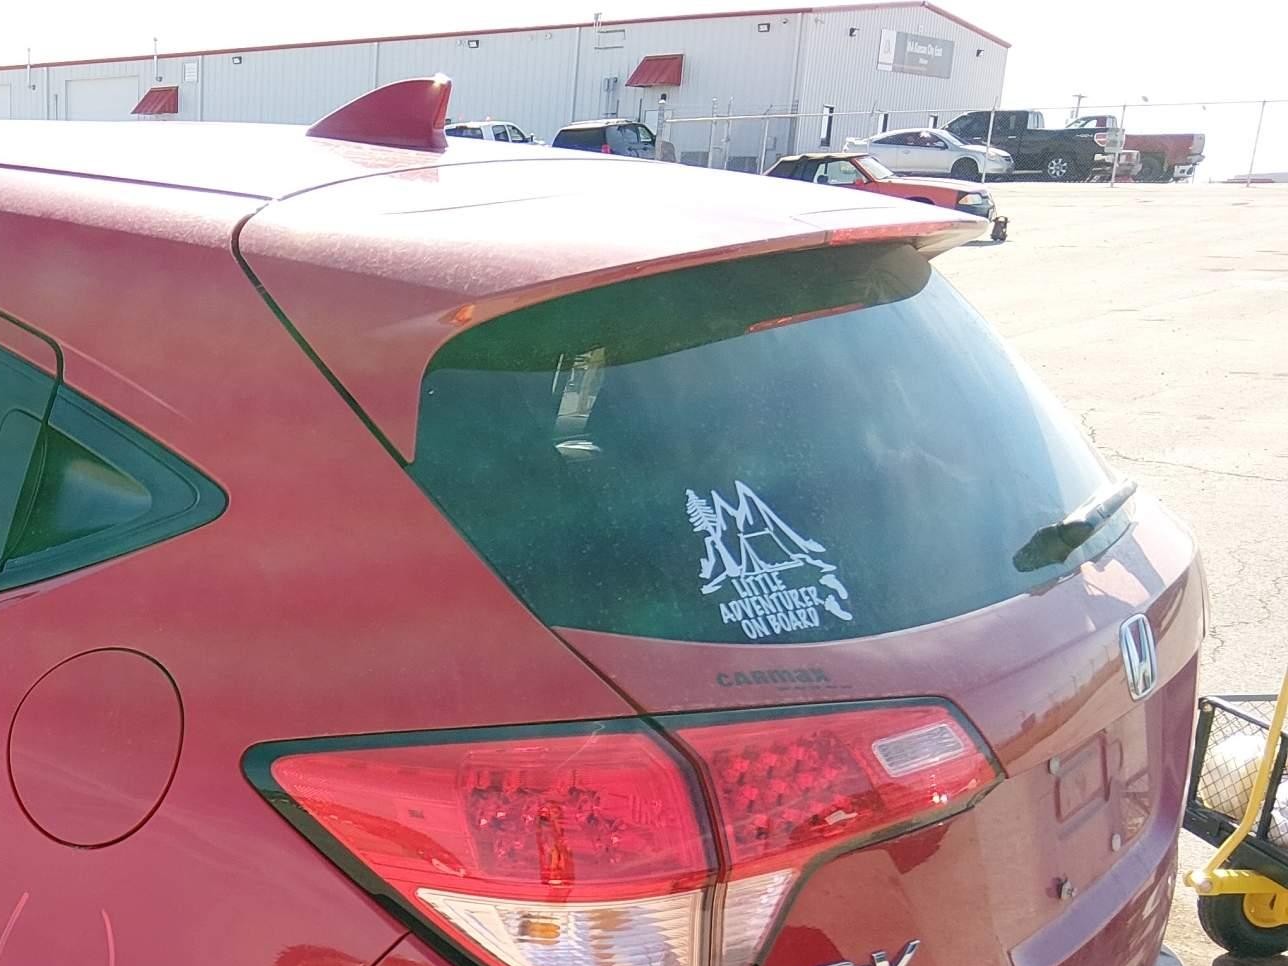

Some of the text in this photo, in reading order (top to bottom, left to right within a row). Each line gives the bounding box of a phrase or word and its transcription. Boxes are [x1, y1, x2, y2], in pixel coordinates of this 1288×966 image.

[731, 571, 787, 598] LITTLE
[719, 586, 826, 624] ADVENTURER
[741, 607, 821, 640] ON BOARD
